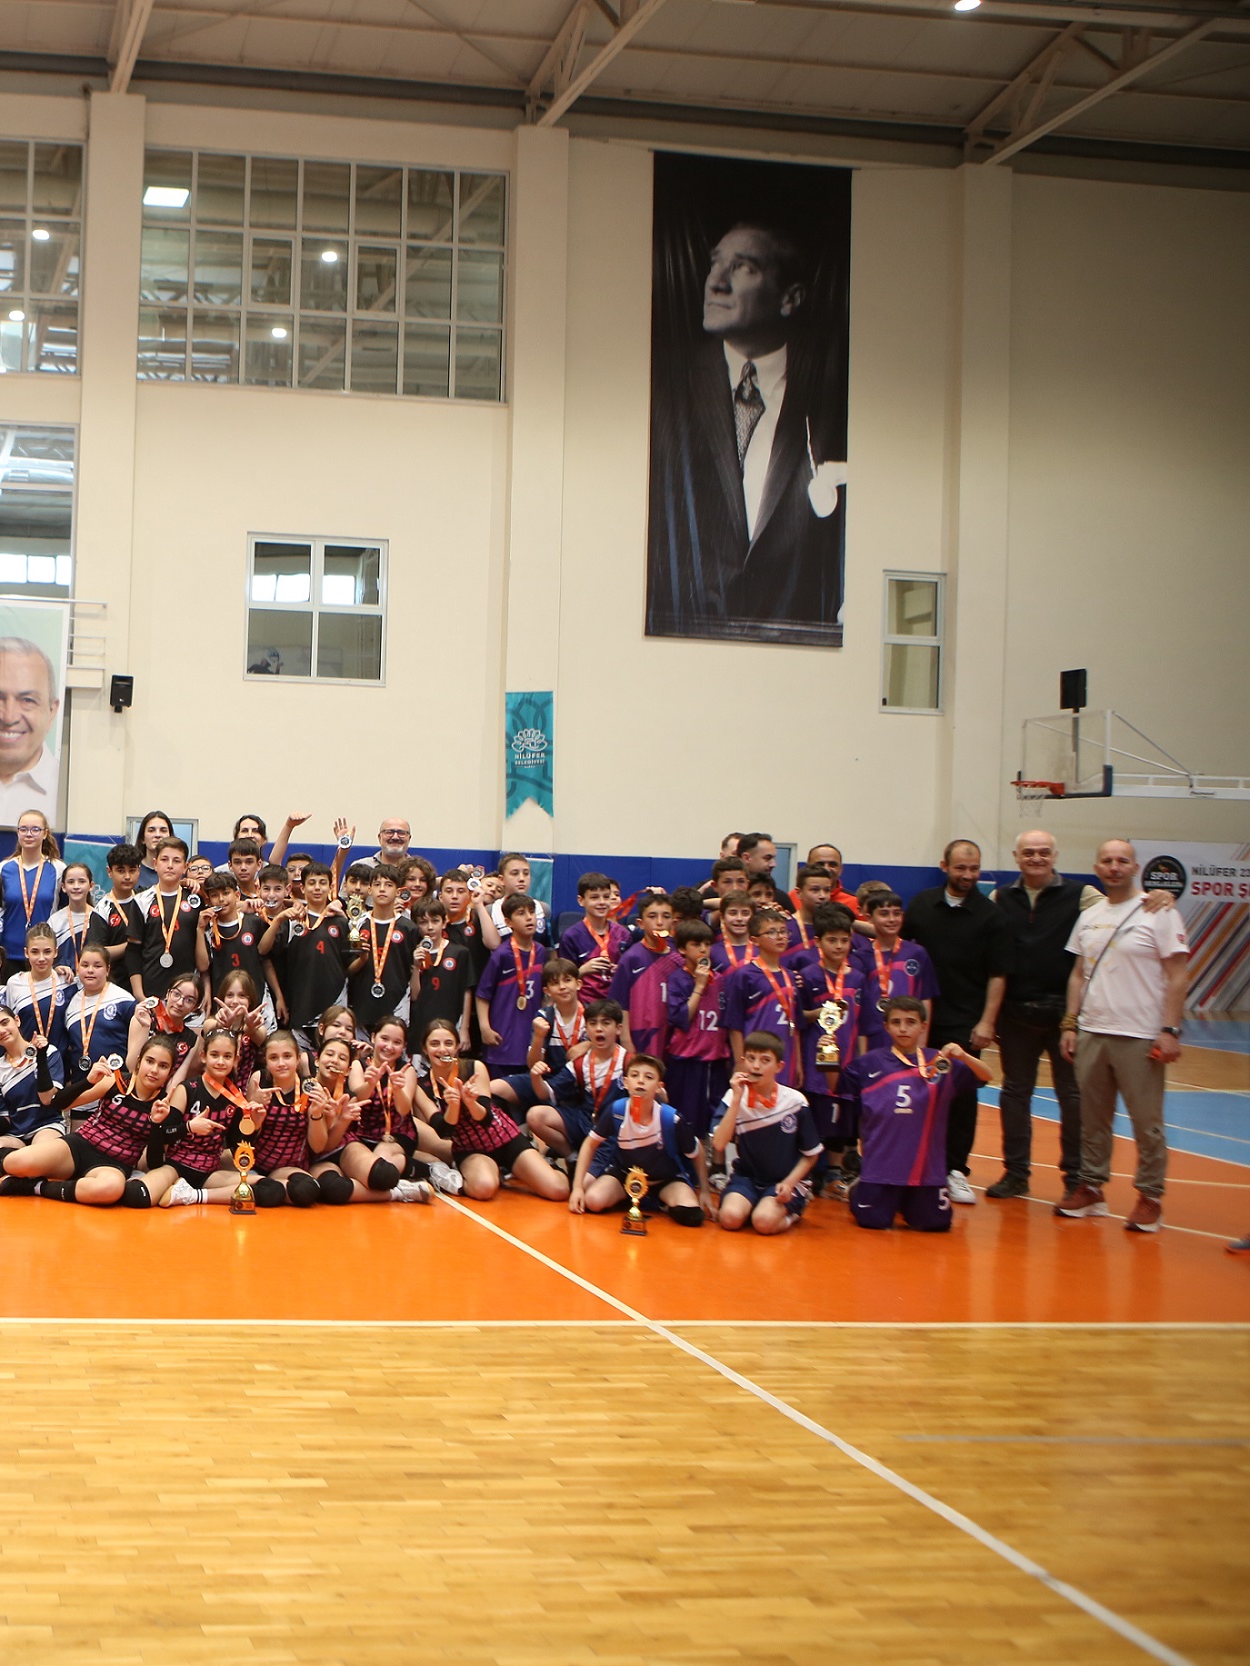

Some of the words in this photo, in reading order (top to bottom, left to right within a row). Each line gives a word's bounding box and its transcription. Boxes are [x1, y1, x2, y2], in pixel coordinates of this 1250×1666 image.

[1150, 872, 1178, 880] SPOR
[1191, 864, 1236, 877] NİLÜFER
[1191, 881, 1234, 896] SPOR
[1238, 883, 1250, 898] Ş
[315, 940, 325, 954] 4
[231, 953, 240, 966] 3
[431, 977, 441, 991] 9
[525, 980, 534, 999] 3
[698, 1010, 718, 1031] 12
[775, 1004, 789, 1025] 2
[896, 1085, 911, 1108] 5
[190, 1100, 201, 1116] 4
[831, 1102, 839, 1124] 1
[938, 1187, 950, 1211] 5
